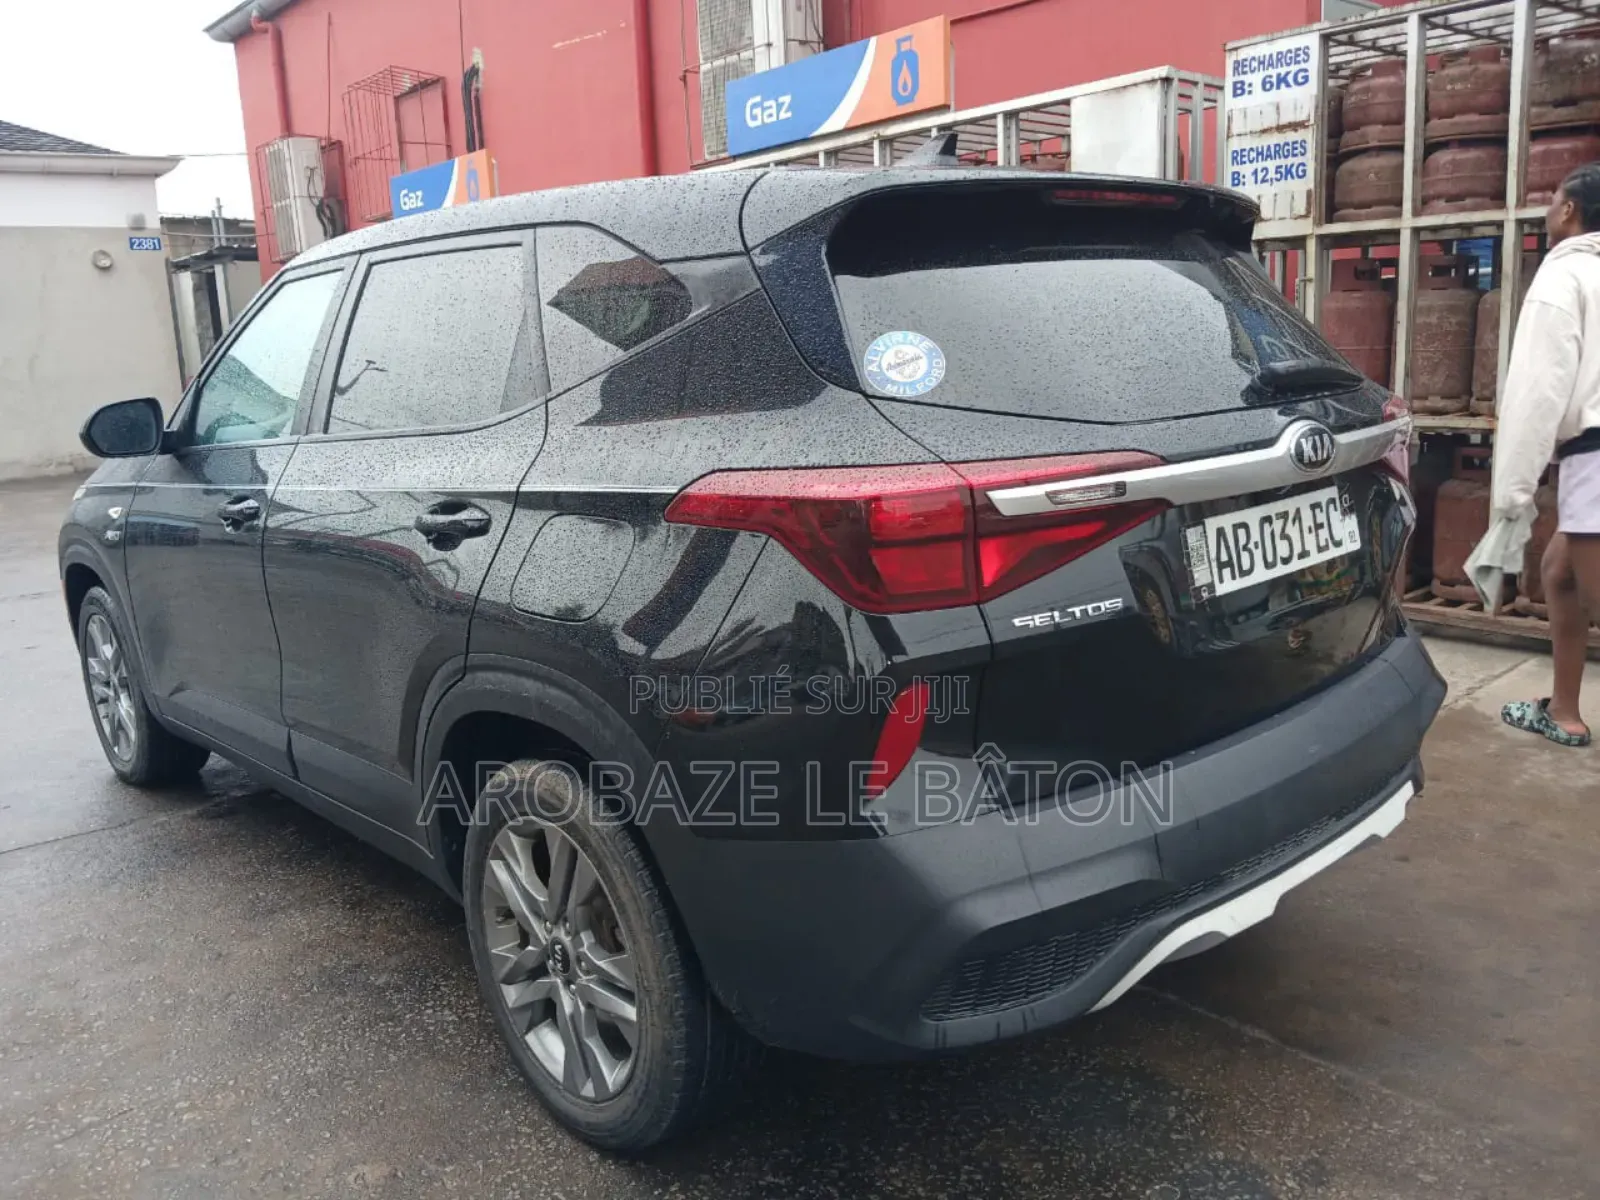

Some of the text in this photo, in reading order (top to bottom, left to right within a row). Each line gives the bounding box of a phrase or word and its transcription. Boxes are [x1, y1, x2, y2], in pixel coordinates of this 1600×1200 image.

[1232, 45, 1311, 77] RECHARGES
[1232, 68, 1310, 98] B: 6KG
[745, 94, 793, 128] Gaz
[1231, 139, 1308, 166] RECHARGES
[1231, 162, 1307, 187] B: 12,5KG
[400, 189, 424, 210] Gaz
[132, 238, 160, 250] 2381
[884, 359, 943, 393] MILFORD
[1300, 433, 1332, 463] KIA
[1011, 598, 1123, 628] SELTOS
